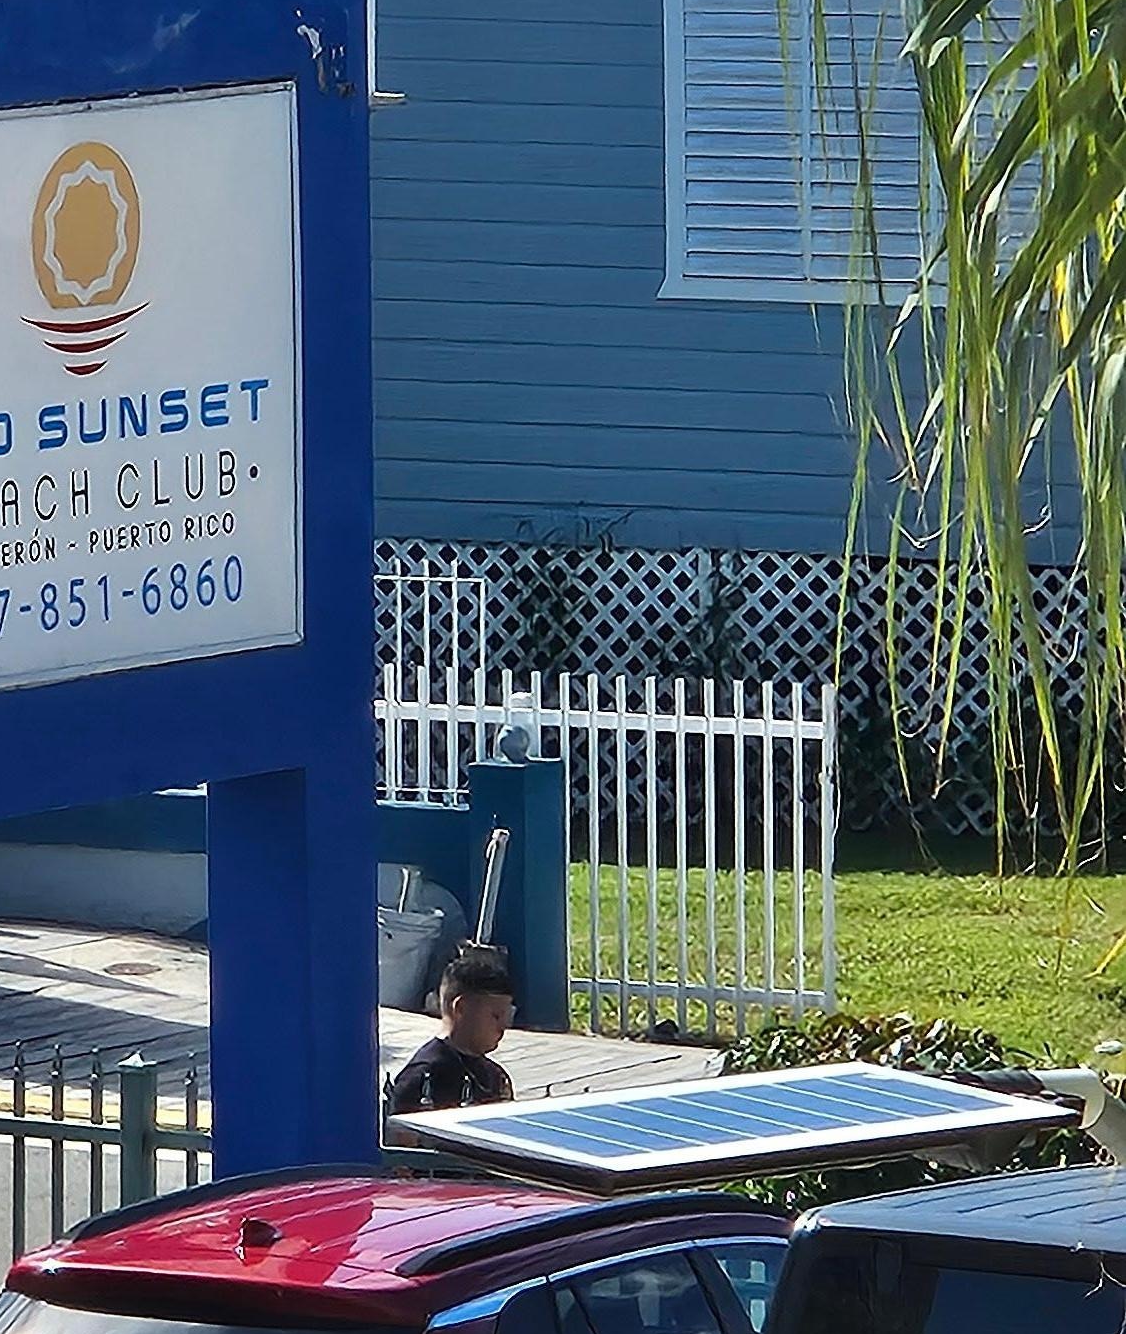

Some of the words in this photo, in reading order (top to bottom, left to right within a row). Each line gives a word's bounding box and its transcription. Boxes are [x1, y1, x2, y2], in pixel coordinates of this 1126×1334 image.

[38, 378, 269, 450] SUNSET
[117, 449, 236, 509] CLUB
[89, 520, 171, 554] PUERTO
[184, 512, 235, 540] RICO
